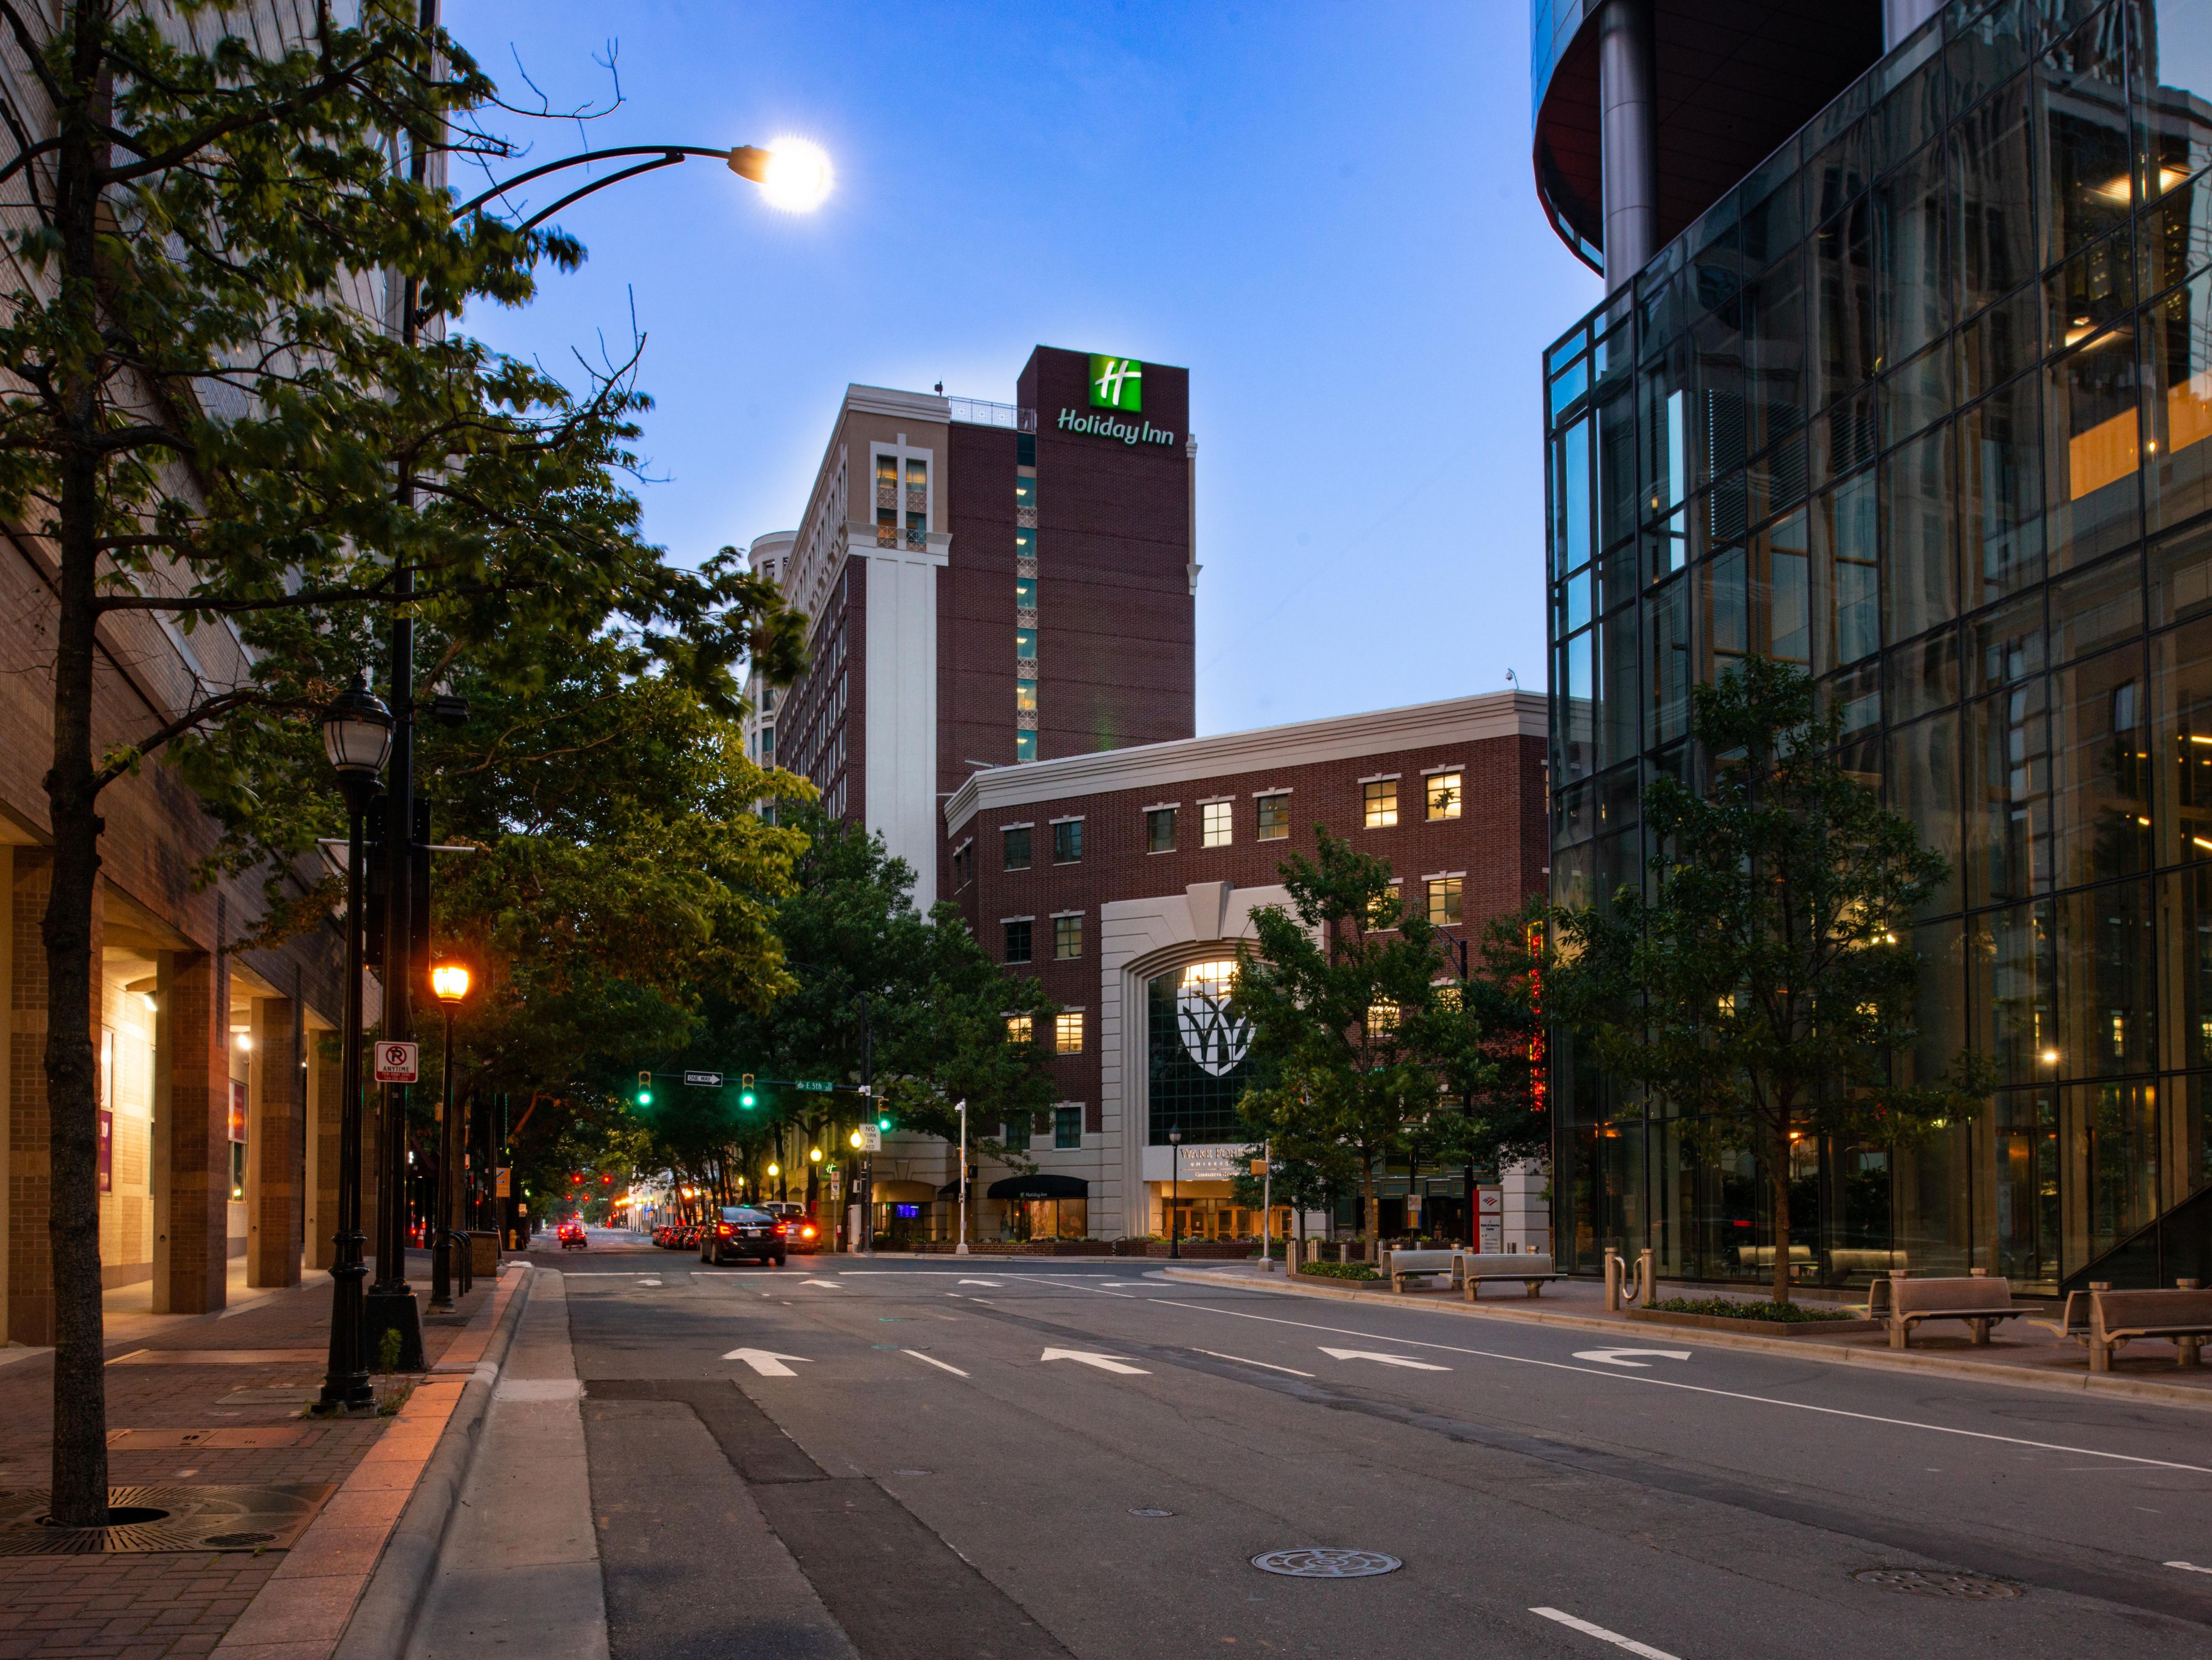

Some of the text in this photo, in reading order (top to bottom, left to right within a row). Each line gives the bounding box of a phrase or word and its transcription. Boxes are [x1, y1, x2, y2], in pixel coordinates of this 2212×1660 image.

[1057, 408, 1173, 446] Holiday Inn
[1180, 1148, 1213, 1159] WAKE
